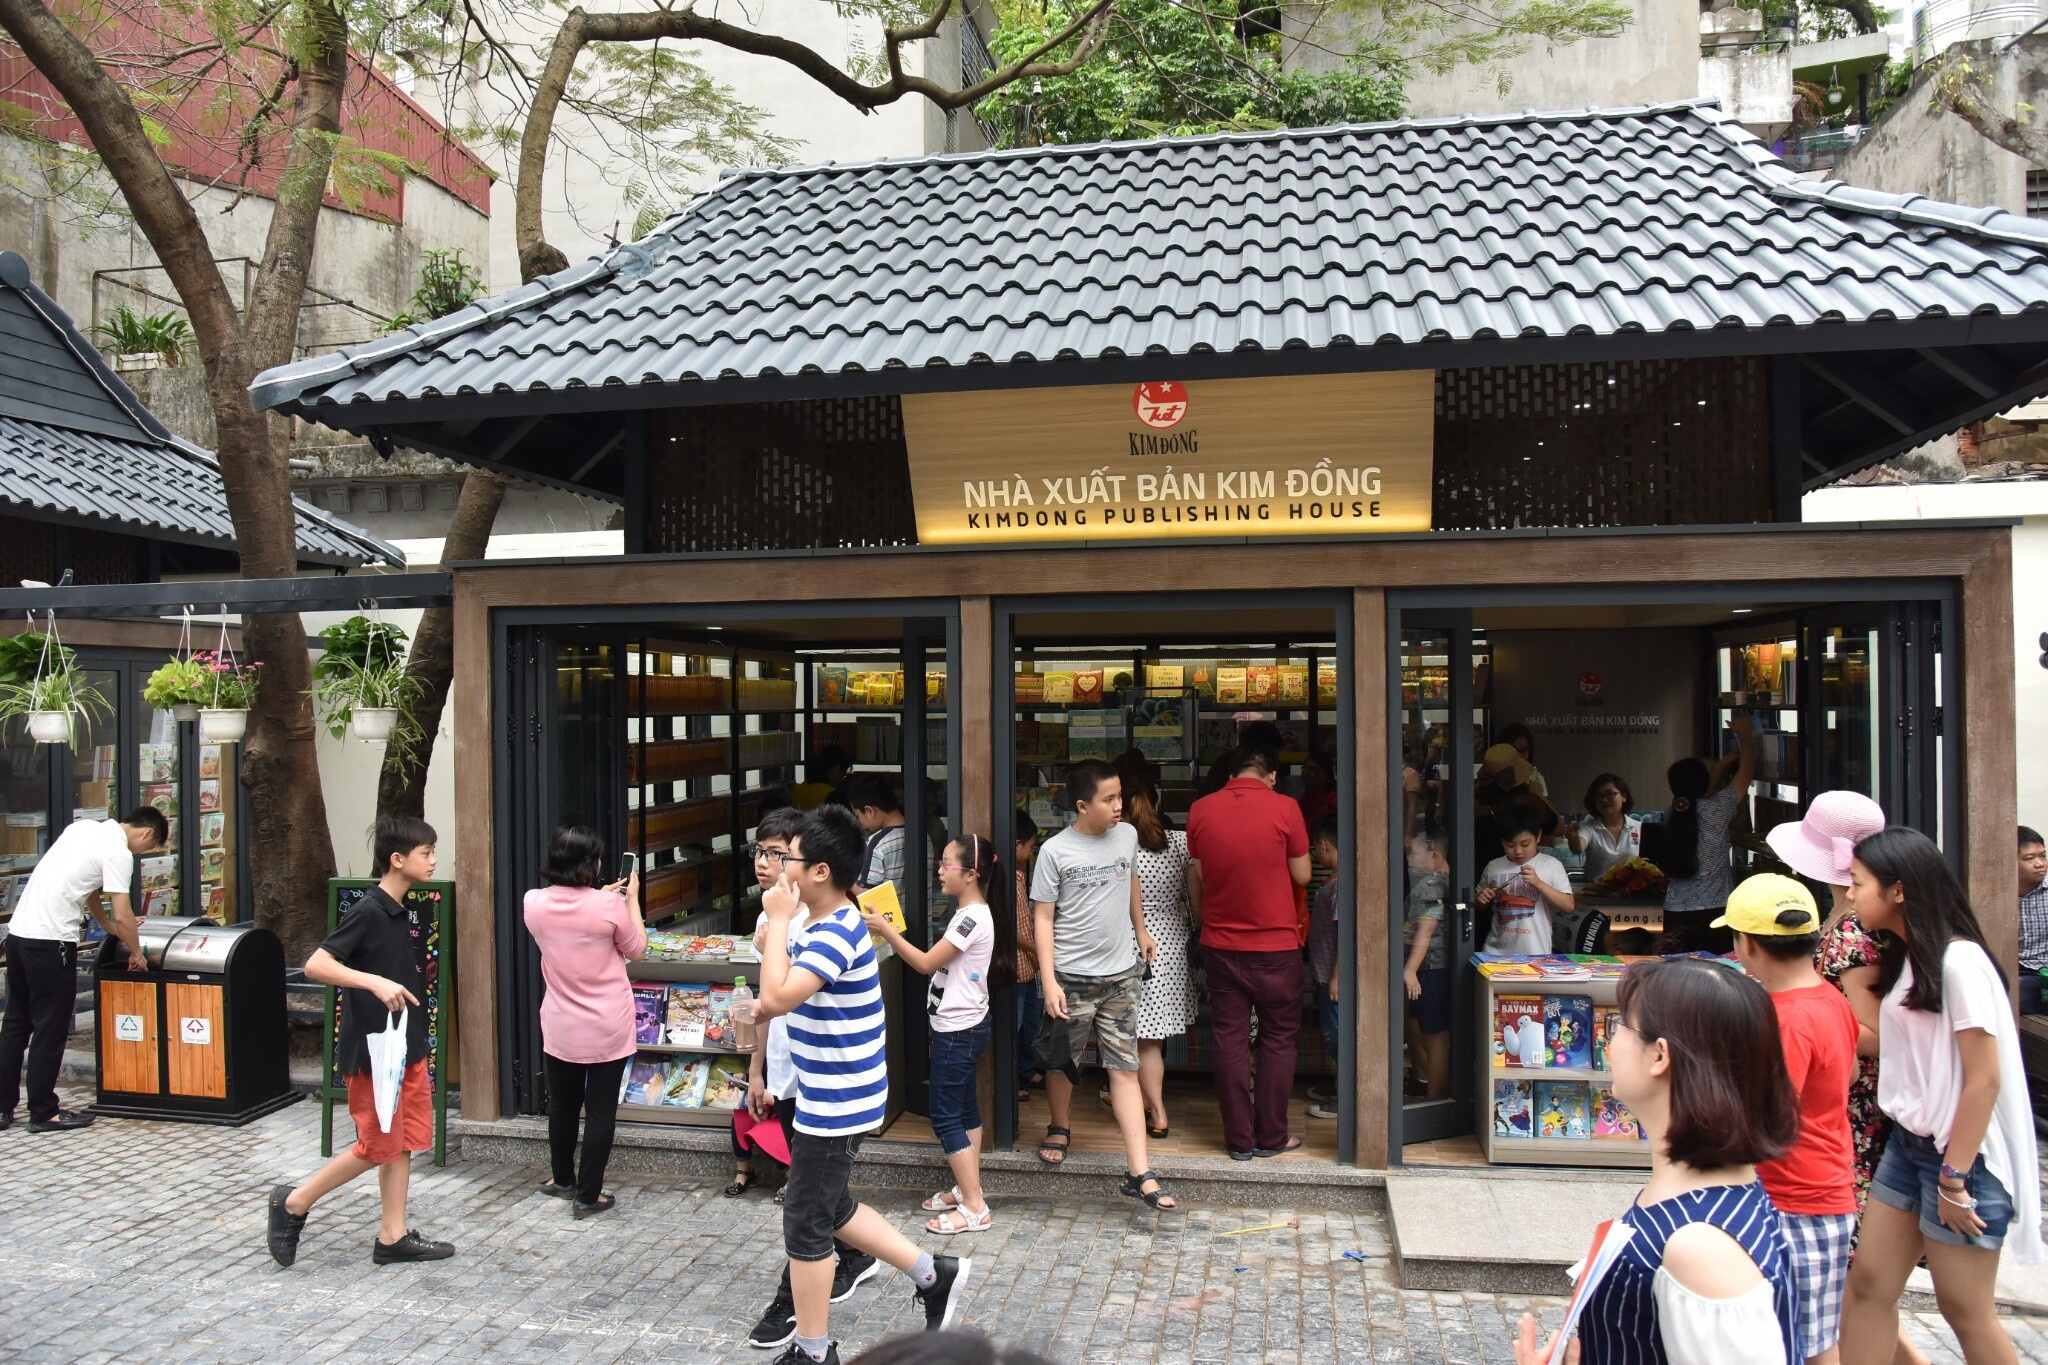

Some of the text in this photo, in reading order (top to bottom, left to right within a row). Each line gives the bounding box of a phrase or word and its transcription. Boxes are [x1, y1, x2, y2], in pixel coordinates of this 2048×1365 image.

[964, 458, 1381, 508] NHÀ XUẤT BẢN KIM ĐỒNG
[968, 501, 1381, 528] KIMDONG PUBLISHING HOUSE
[1606, 716, 1626, 726] KIM
[1501, 1004, 1539, 1014] BAYMAX
